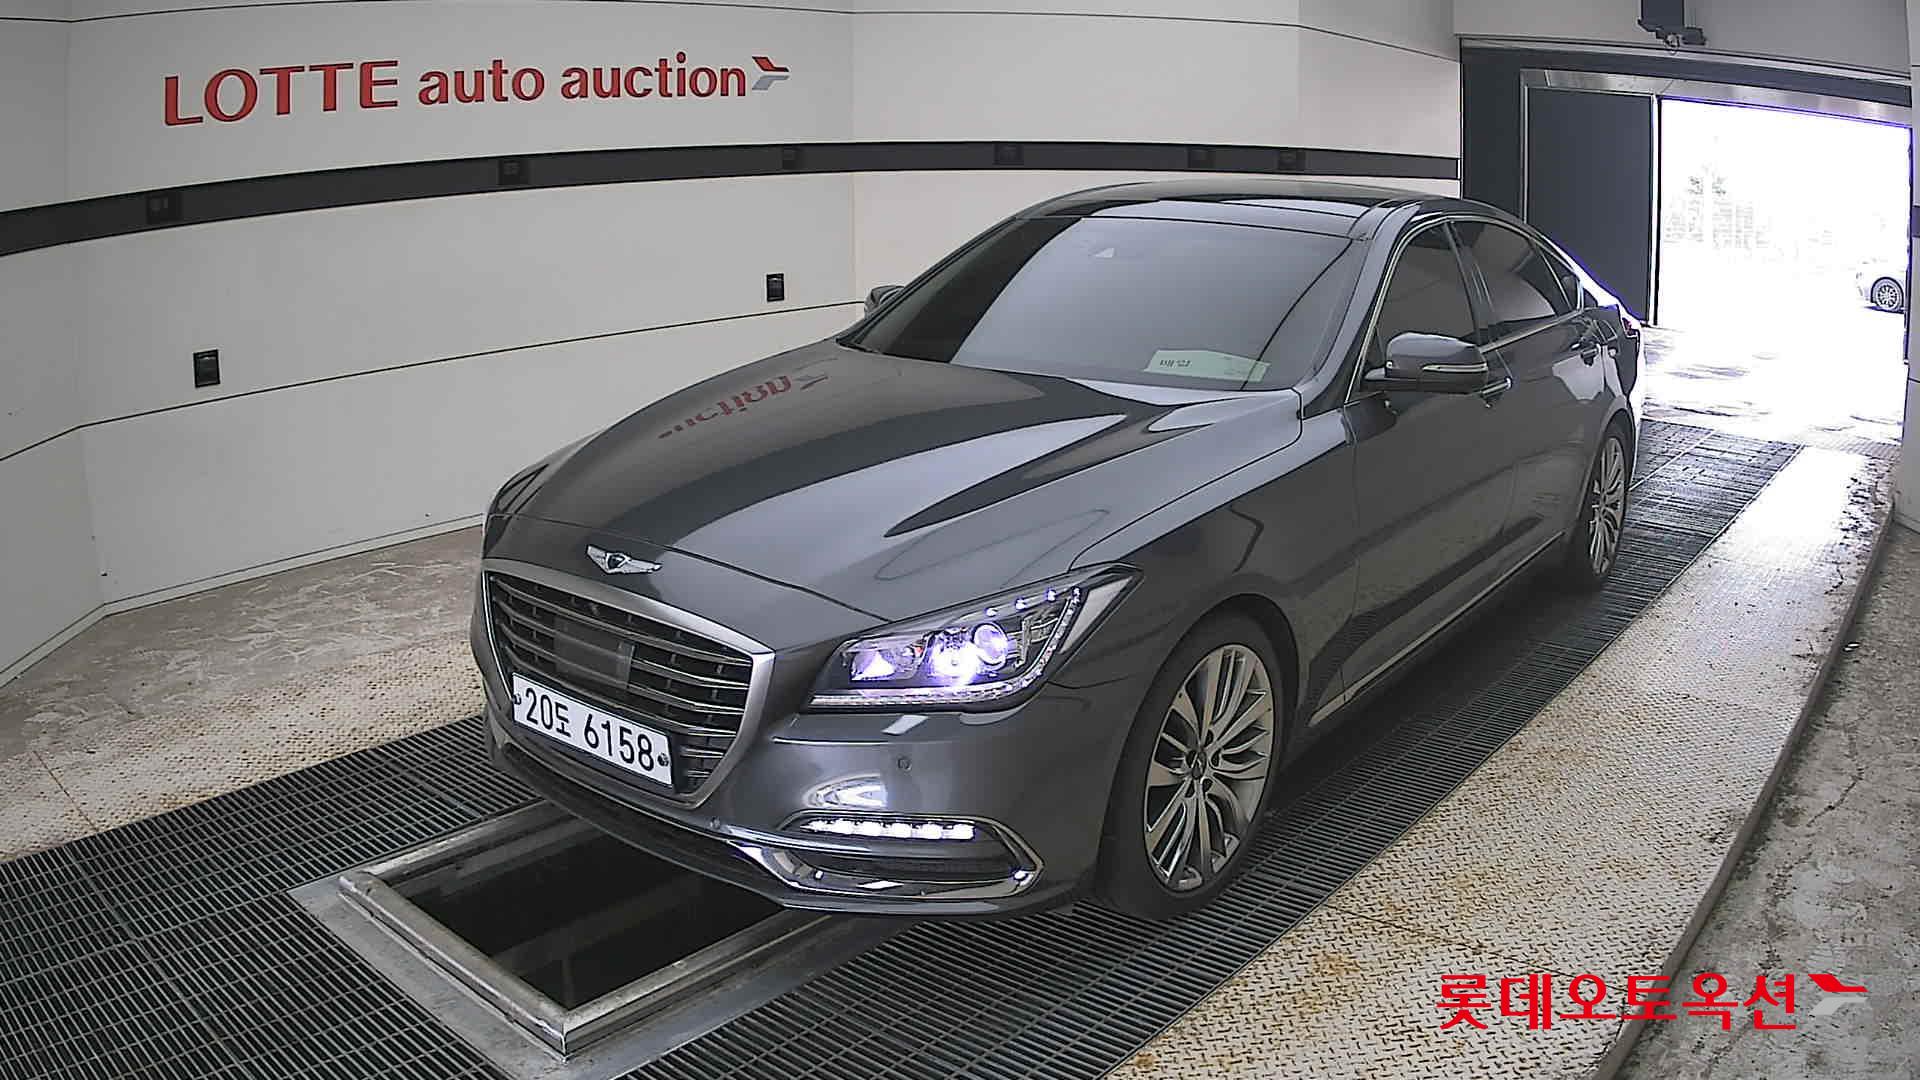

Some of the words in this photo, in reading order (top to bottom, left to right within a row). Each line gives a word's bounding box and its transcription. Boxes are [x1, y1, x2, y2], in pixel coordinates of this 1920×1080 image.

[164, 60, 399, 126] LOTTE
[417, 59, 546, 106] auto
[560, 51, 747, 100] auction
[525, 687, 572, 738] 20도
[583, 713, 655, 772] 6158
